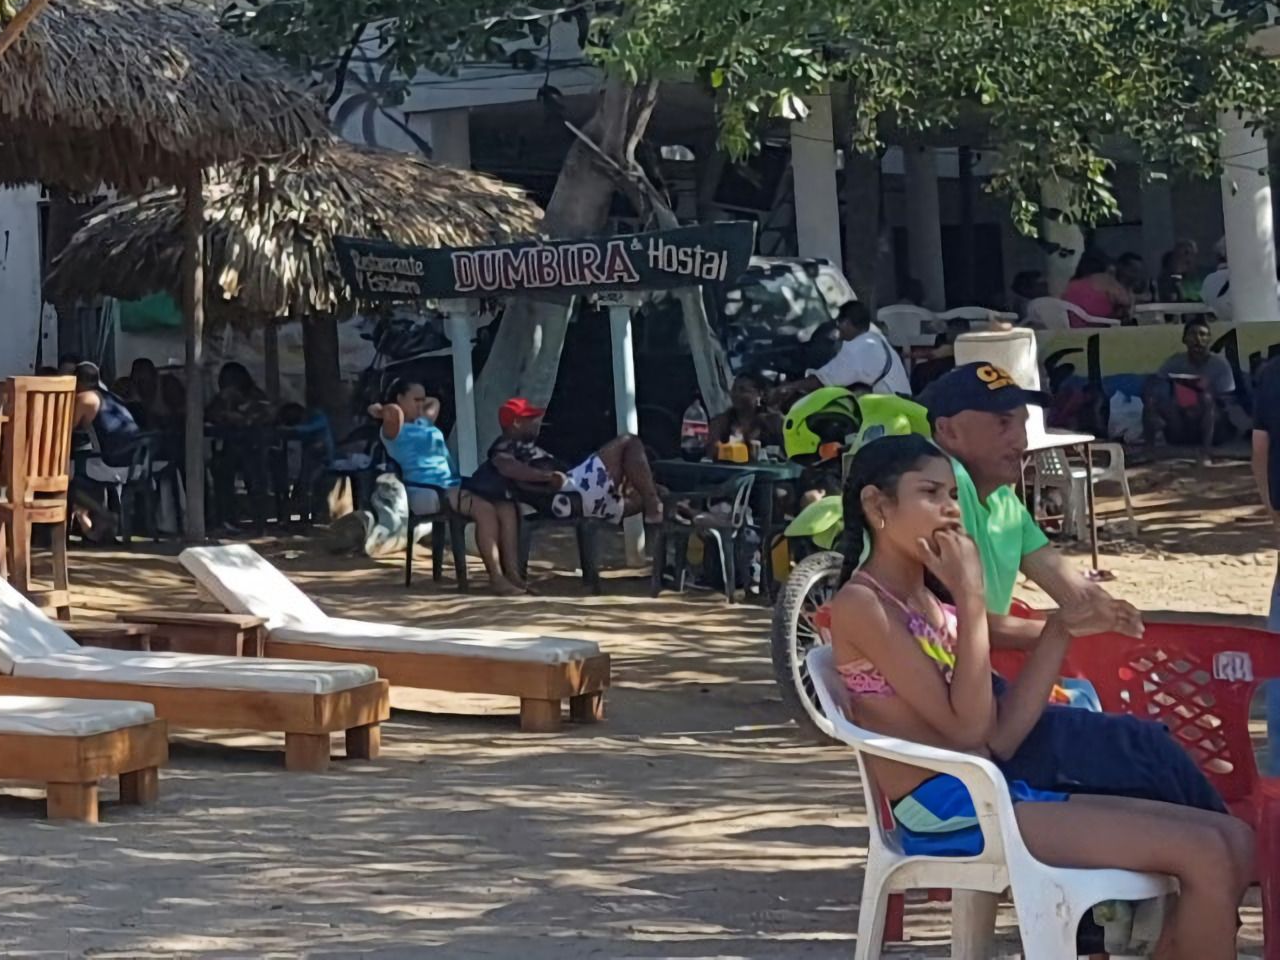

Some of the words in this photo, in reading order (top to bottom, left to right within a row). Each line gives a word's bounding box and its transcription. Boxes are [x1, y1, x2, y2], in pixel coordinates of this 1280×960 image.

[451, 241, 640, 292] DUMBIRA
[630, 238, 643, 251] &
[648, 236, 728, 281] Hostal
